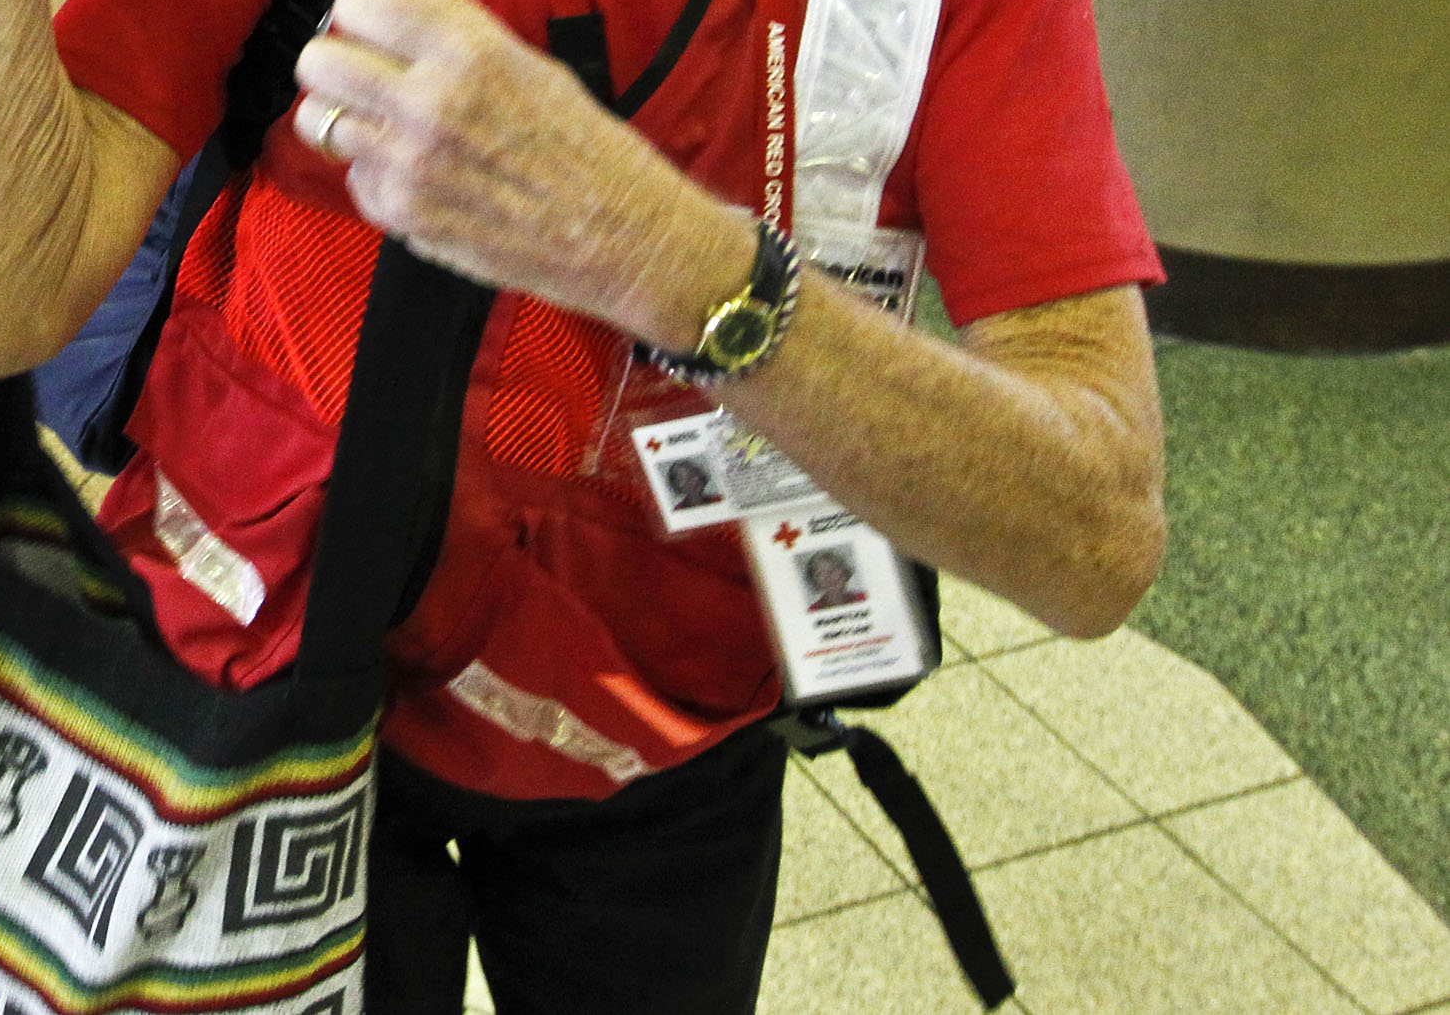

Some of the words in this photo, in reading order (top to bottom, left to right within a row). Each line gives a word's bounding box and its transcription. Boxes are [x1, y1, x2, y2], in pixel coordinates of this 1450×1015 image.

[766, 19, 786, 131] AMERICAN
[764, 132, 785, 177] RED
[763, 178, 784, 226] CRO
